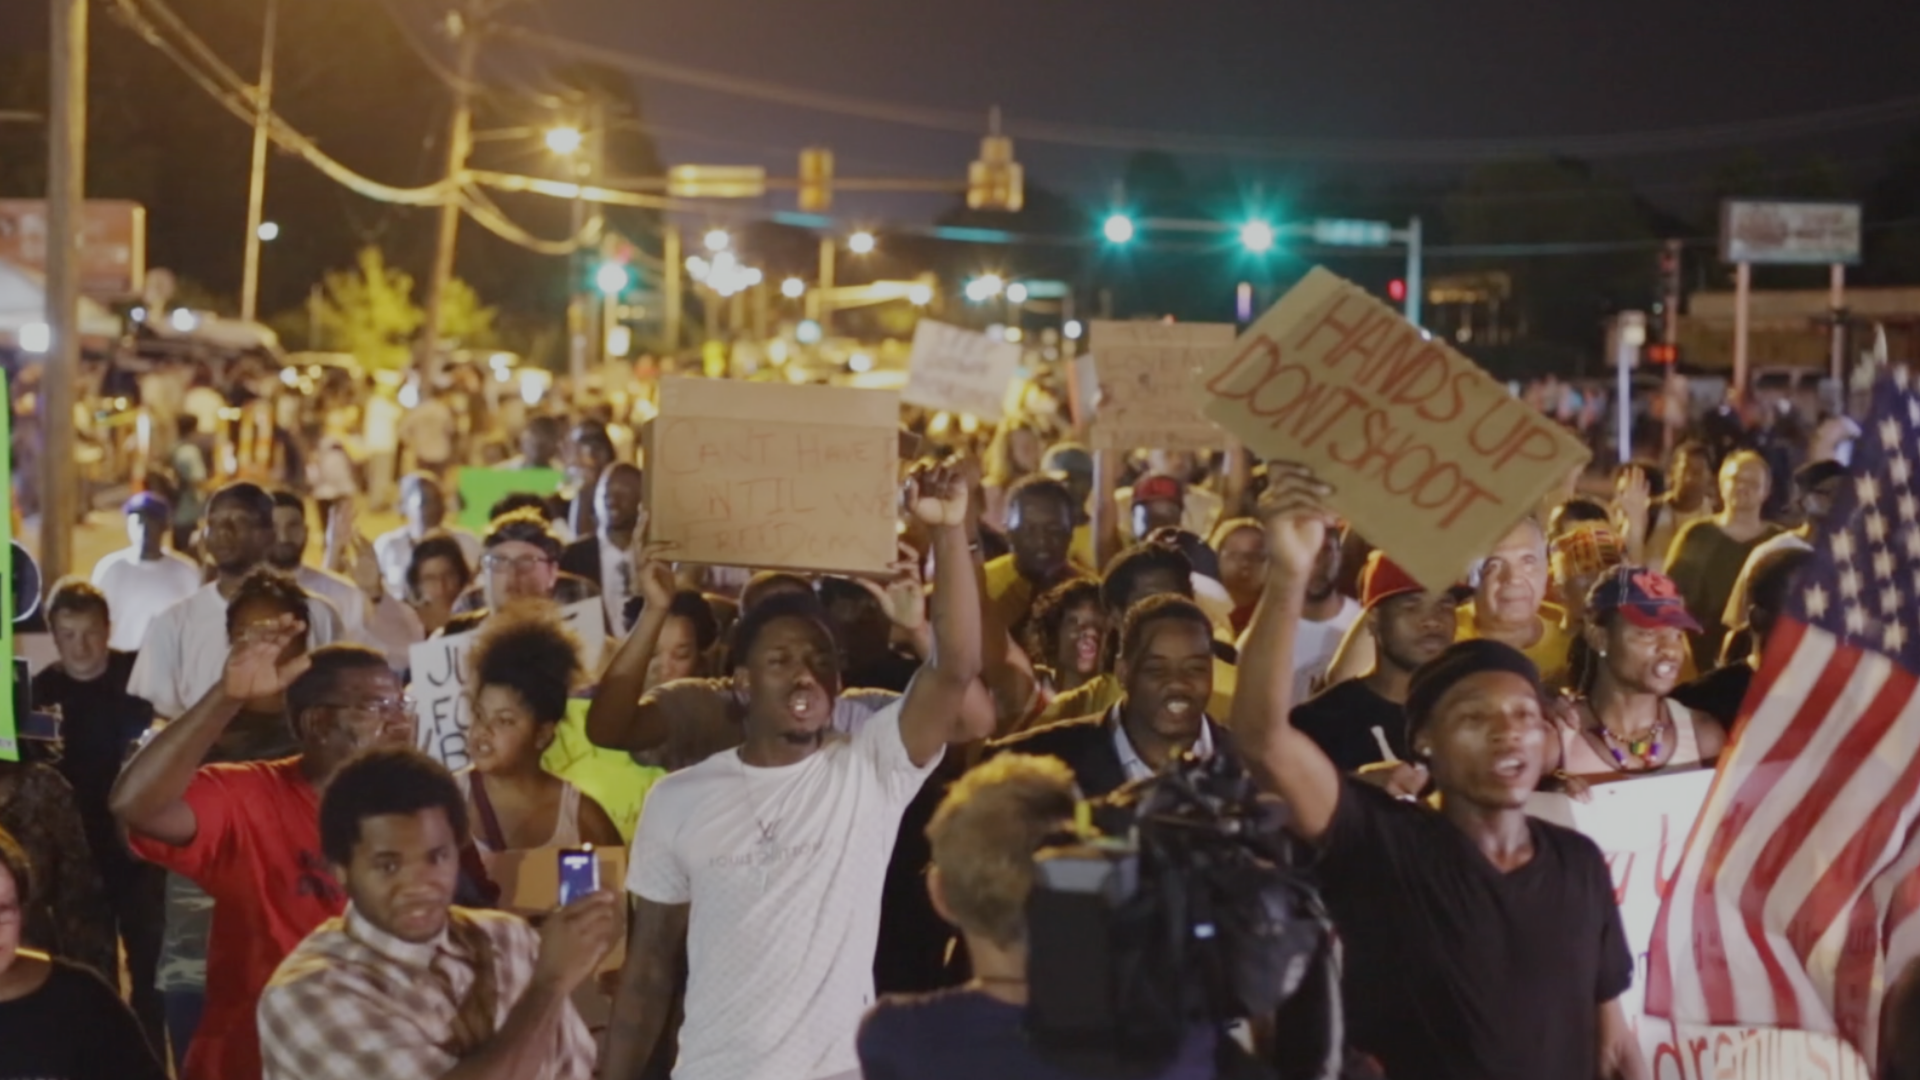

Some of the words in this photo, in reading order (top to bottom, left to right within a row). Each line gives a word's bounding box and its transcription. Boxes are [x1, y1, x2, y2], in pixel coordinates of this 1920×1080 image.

[1295, 294, 1480, 424] HANDS
[1466, 397, 1560, 472] UP
[1327, 407, 1504, 530] SHOOT
